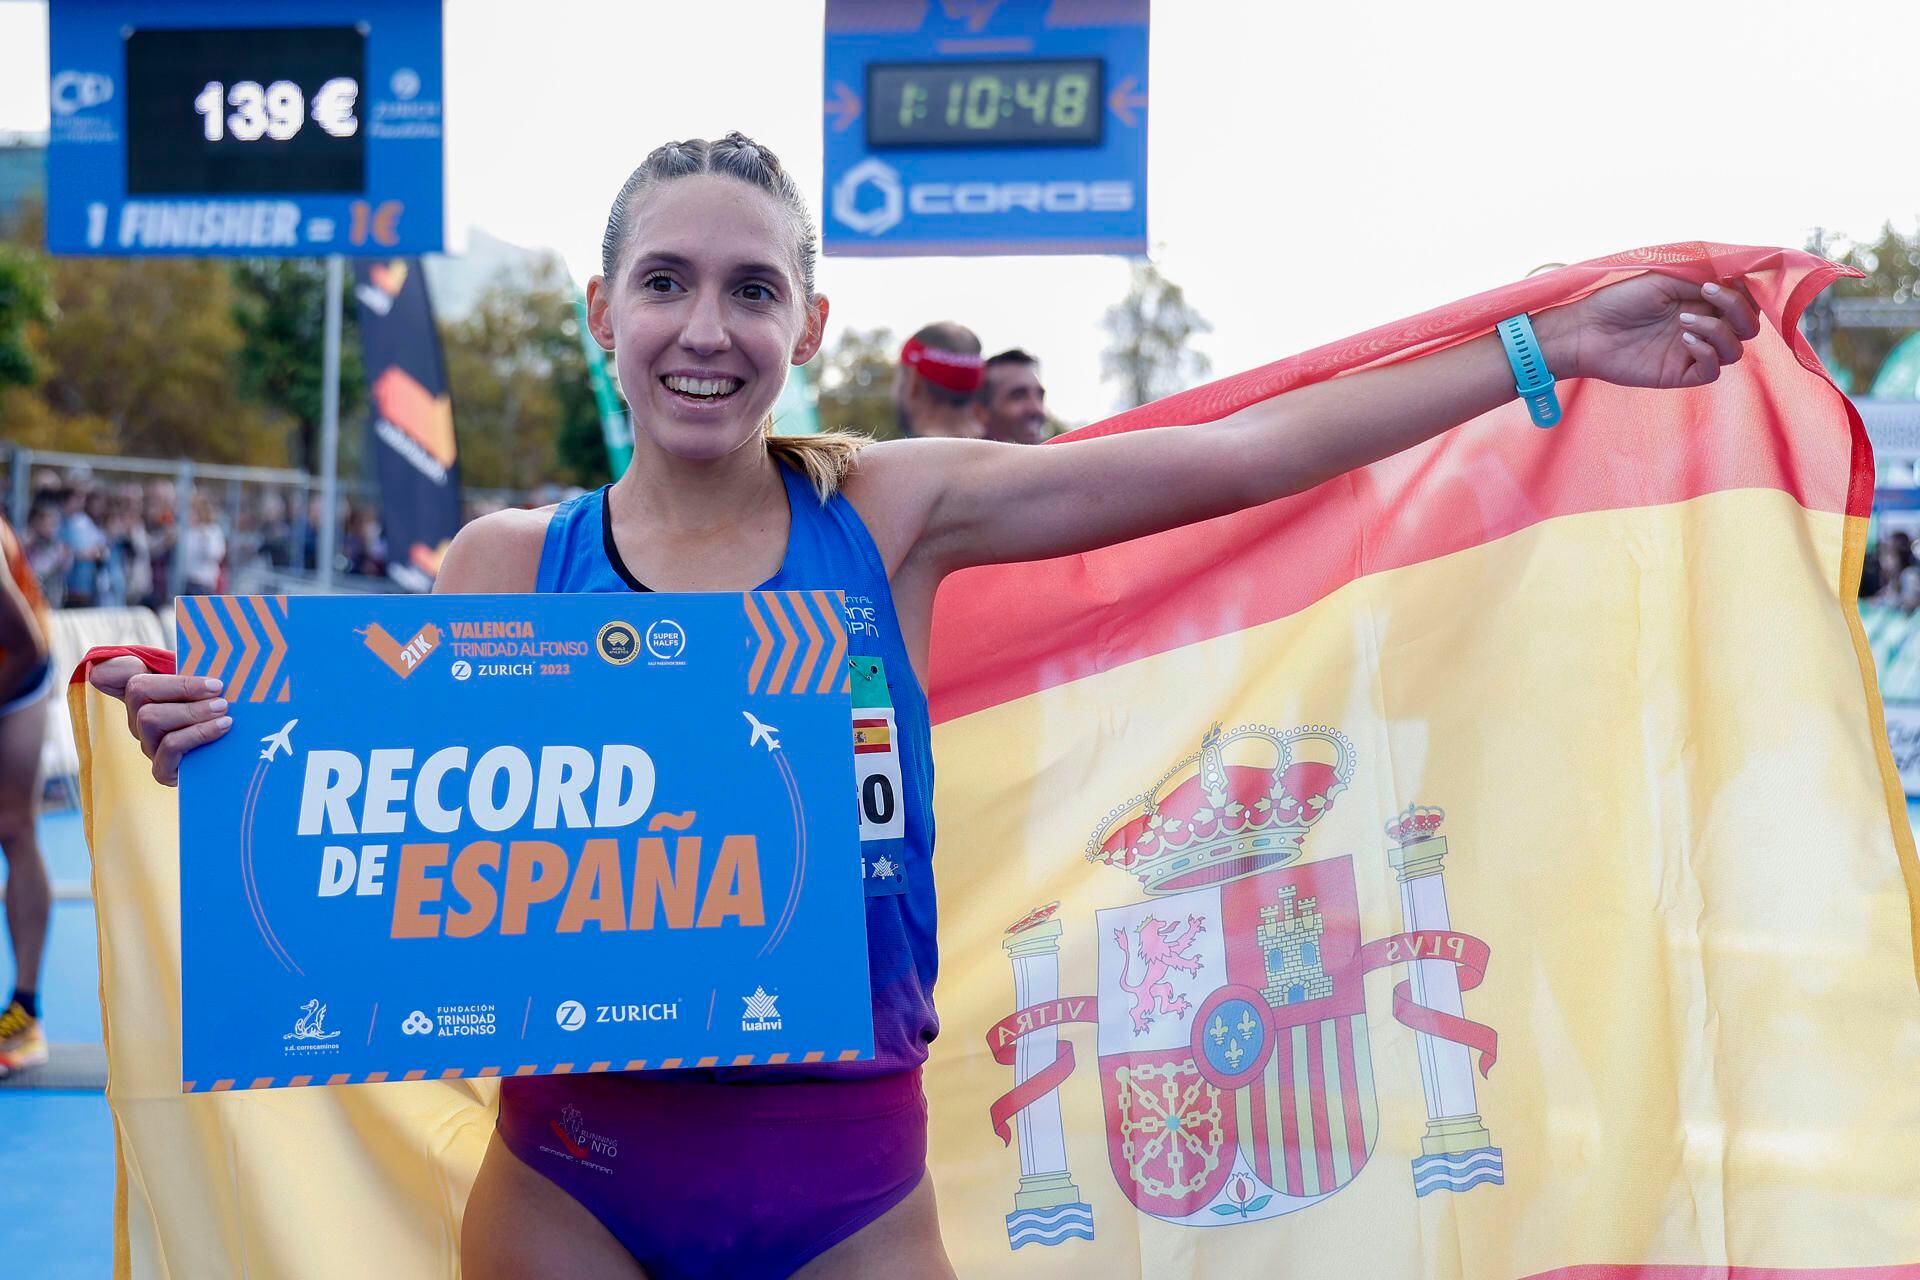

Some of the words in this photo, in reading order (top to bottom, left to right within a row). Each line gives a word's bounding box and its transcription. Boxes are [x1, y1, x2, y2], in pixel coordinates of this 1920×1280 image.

[195, 80, 304, 141] 139
[311, 77, 358, 137] €
[909, 180, 1133, 214] COROS
[87, 203, 107, 247] 1
[118, 202, 300, 247] FINISHER
[451, 621, 534, 638] VALENCIA
[653, 632, 679, 640] SUPER
[400, 633, 433, 669] 21K
[451, 643, 517, 657] TRINIDAD
[519, 641, 588, 656] ALFONSO
[478, 664, 533, 676] ZURICH
[540, 664, 570, 675] 2023
[297, 744, 656, 836] RECORD
[857, 773, 895, 825] 0
[317, 844, 388, 897] DE
[390, 811, 766, 939] ESPAÑA
[437, 1013, 496, 1025] TRINIDAD
[596, 1003, 677, 1023] ZURICH
[438, 1024, 496, 1037] ALFONSO
[741, 1018, 782, 1032] luanvi
